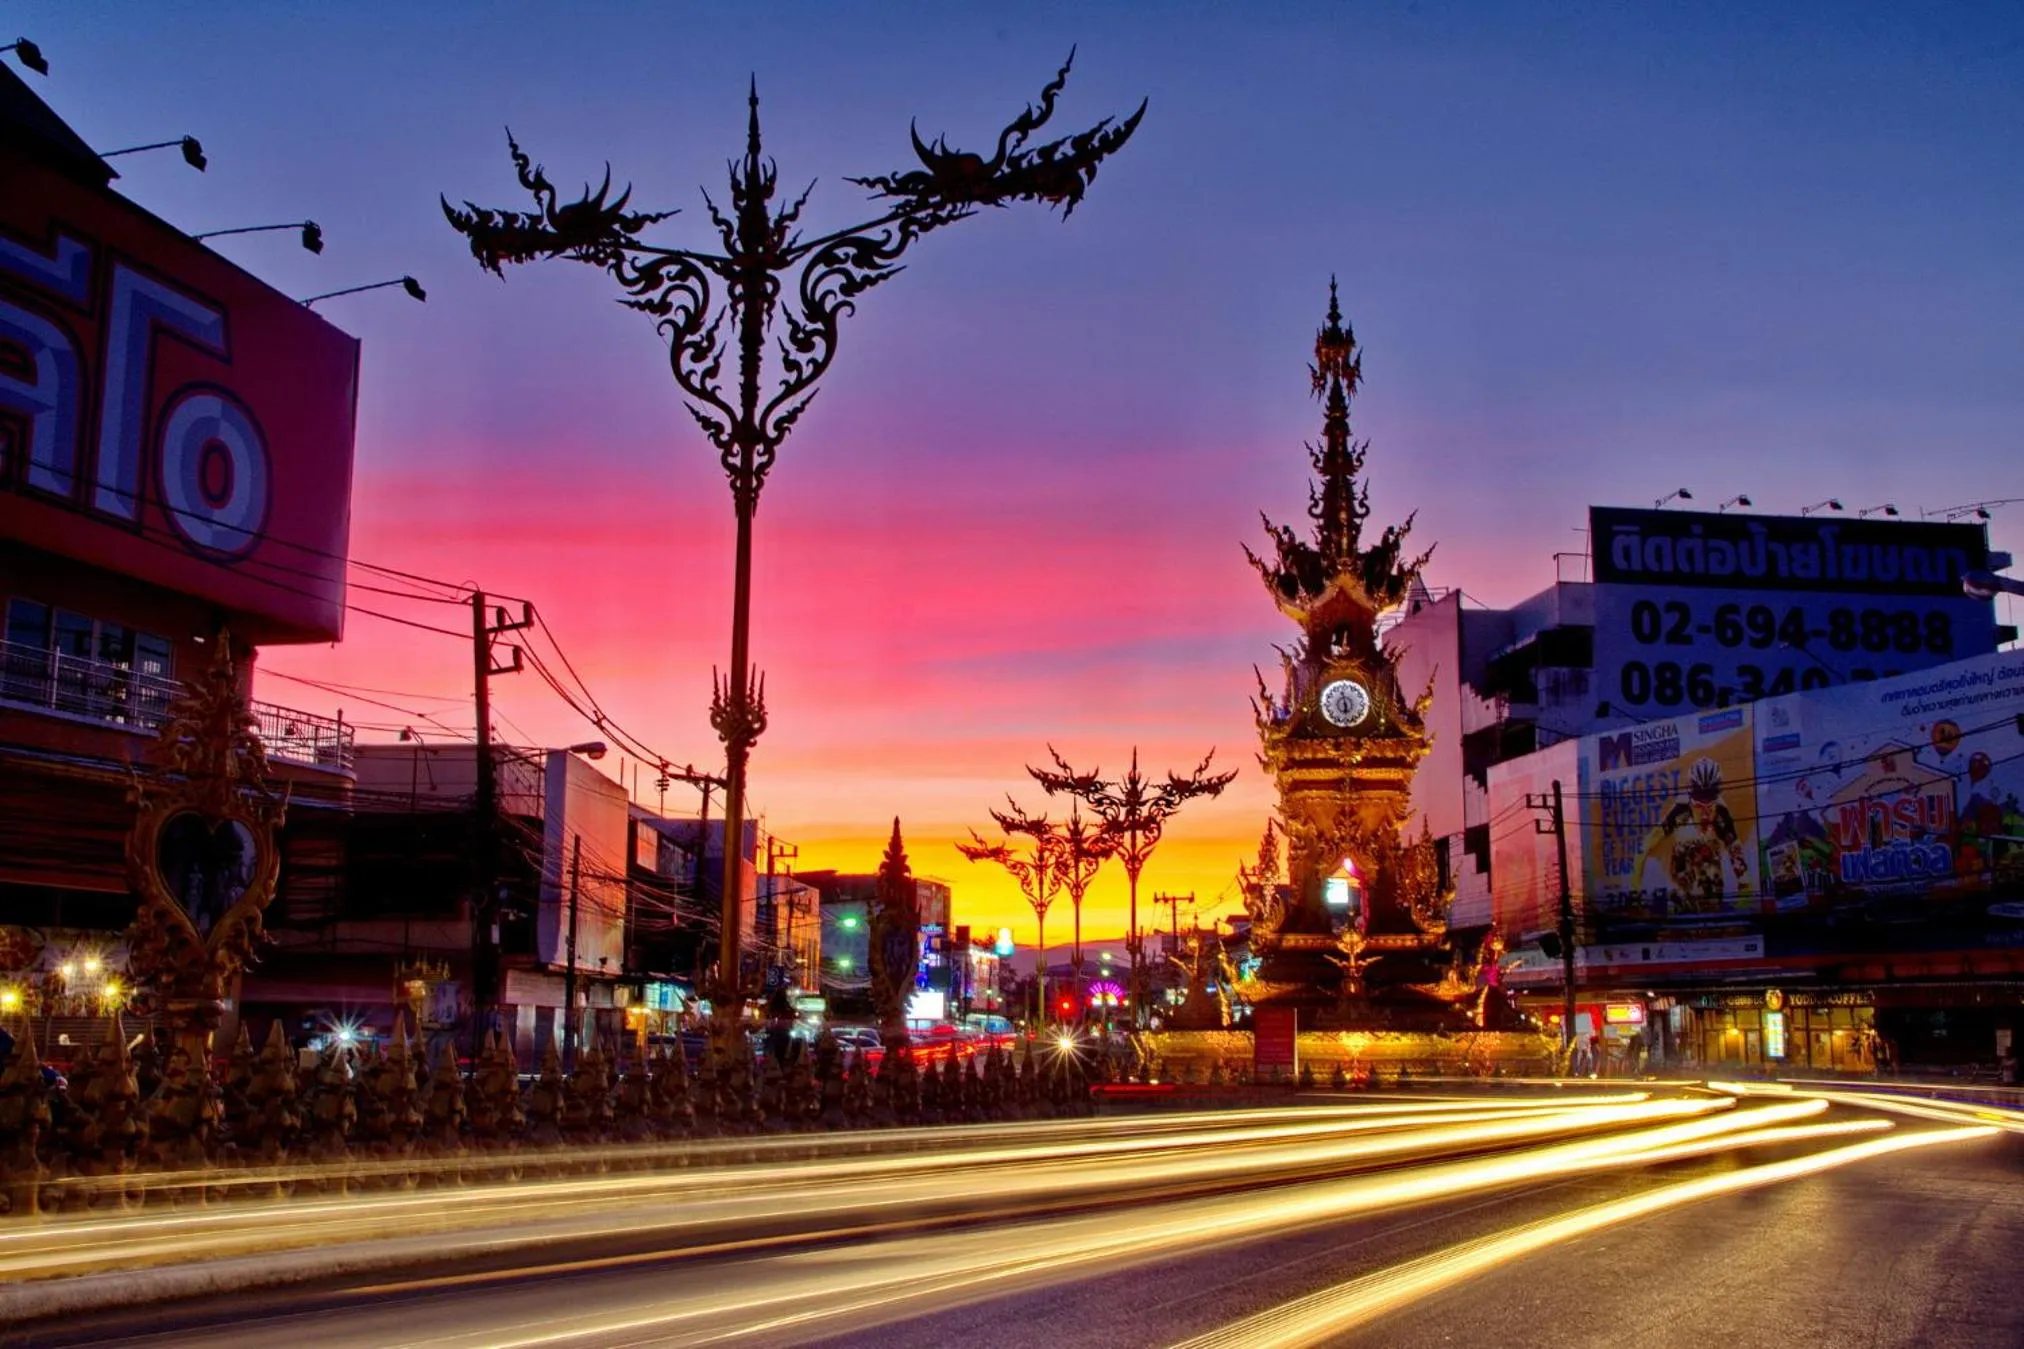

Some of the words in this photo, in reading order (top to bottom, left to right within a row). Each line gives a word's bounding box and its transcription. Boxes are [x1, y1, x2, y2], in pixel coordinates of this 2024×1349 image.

[1631, 599, 1952, 653] 02-694-8888
[1634, 724, 1679, 743] SINGHA
[1601, 770, 1679, 809] BIGGEST
